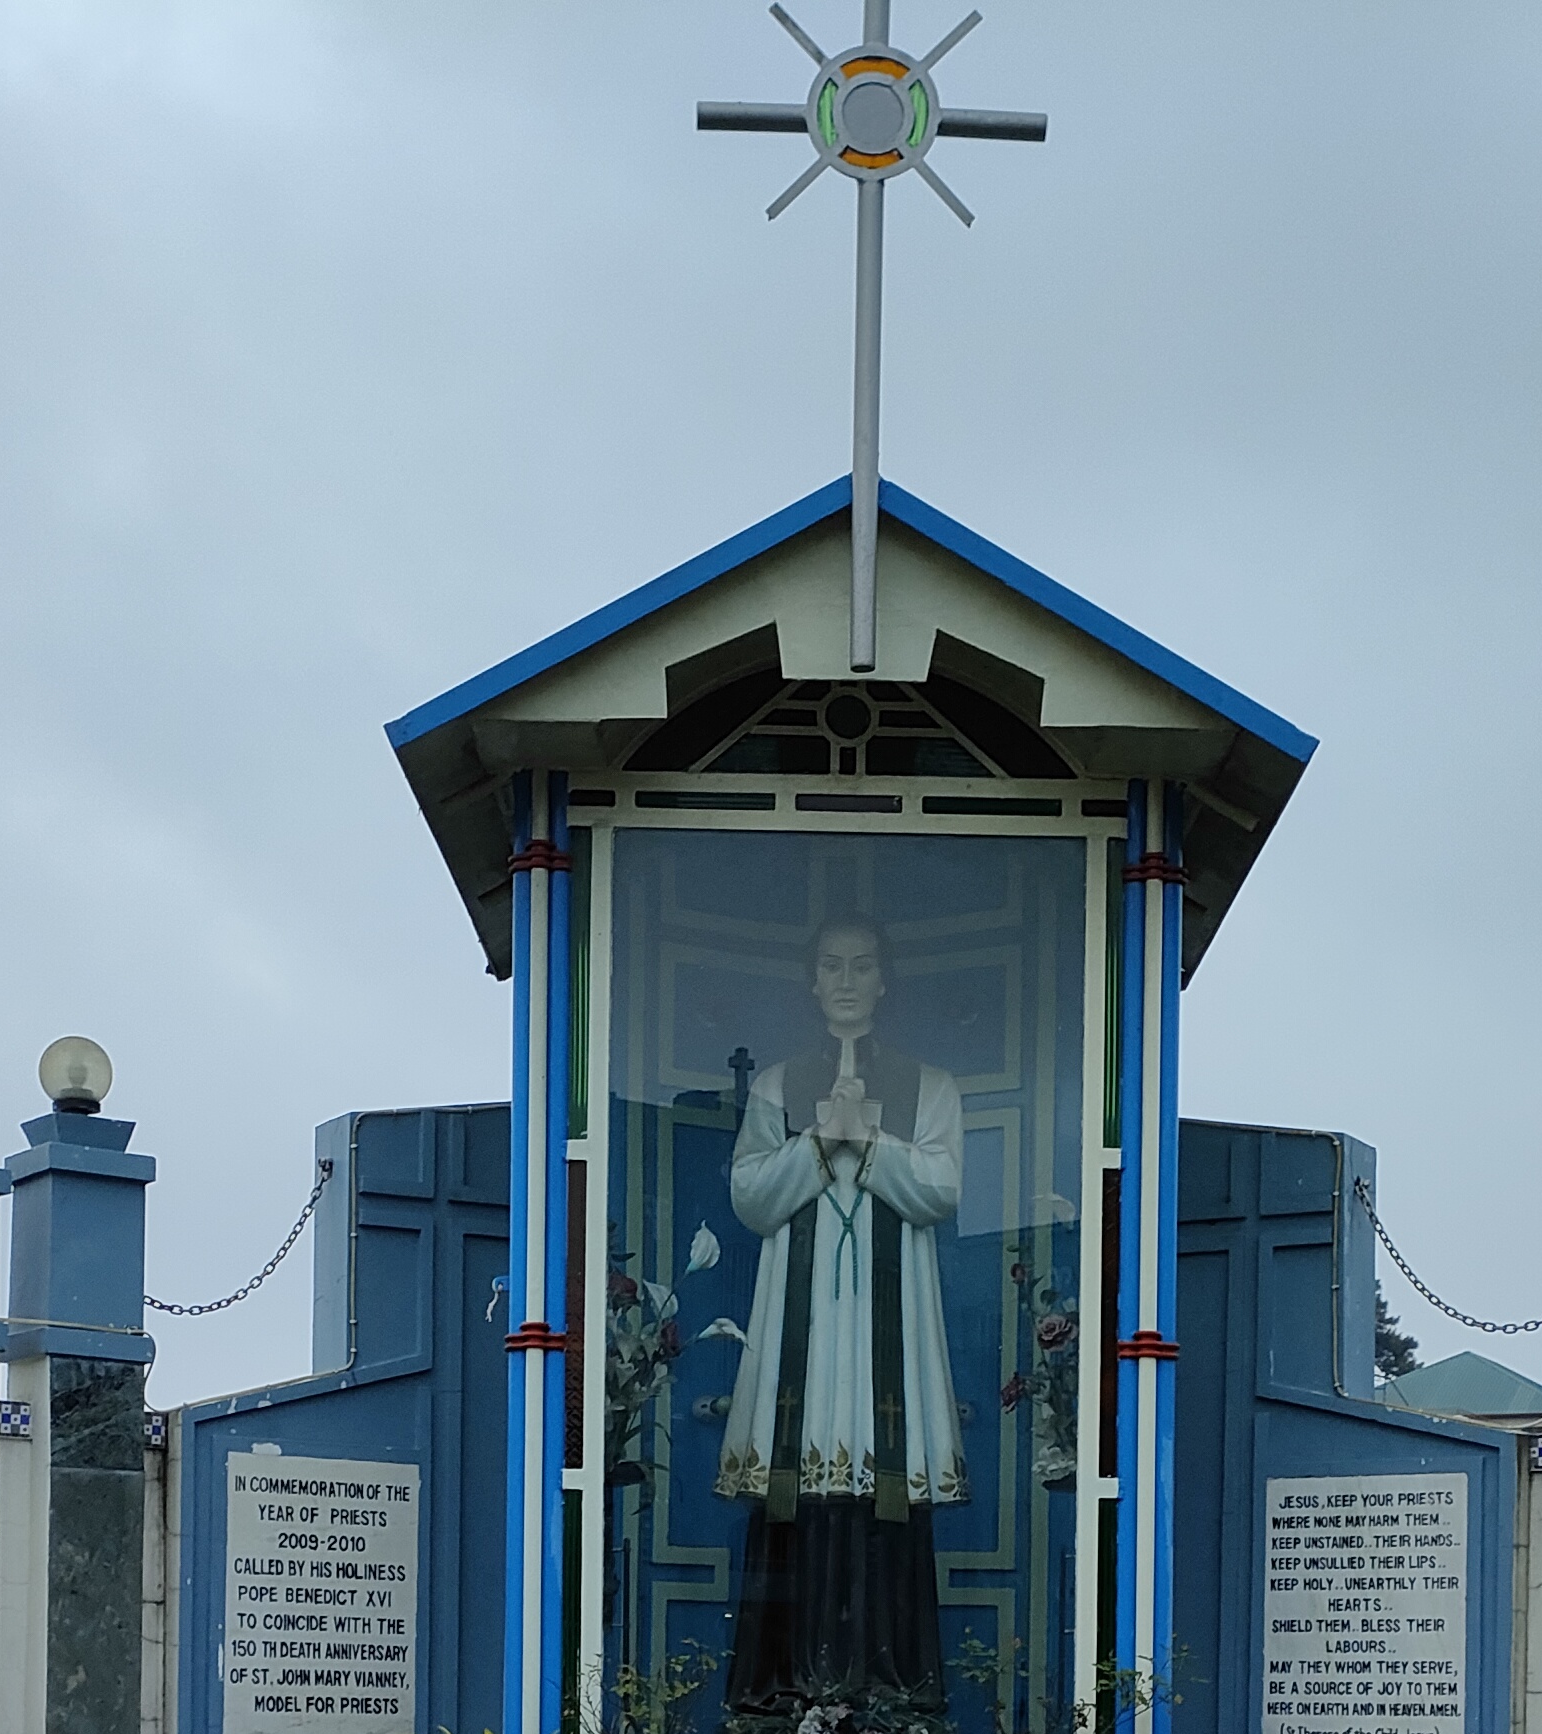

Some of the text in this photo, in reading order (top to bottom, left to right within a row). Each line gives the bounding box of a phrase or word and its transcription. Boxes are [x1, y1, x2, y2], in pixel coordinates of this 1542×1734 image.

[235, 1475, 410, 1502] IN COMMEMORATION OF THE
[1327, 1494, 1357, 1508] KEEP
[1361, 1494, 1393, 1507] YOUR
[1398, 1492, 1454, 1505] PRIESTS
[258, 1504, 387, 1527] YEAR OF PRIESTS
[1272, 1516, 1310, 1529] WHERE
[1314, 1515, 1342, 1528] NONE
[1345, 1515, 1366, 1527] MAY
[1369, 1515, 1399, 1527] HARM
[278, 1533, 366, 1551] 2009-2010
[1271, 1537, 1301, 1550] KEEP
[1374, 1535, 1411, 1548] THEIR
[234, 1558, 406, 1581] CALLED BY HIS HOLINESS
[1271, 1557, 1301, 1570] KEEP
[1304, 1557, 1365, 1570] UNSULLIED
[1370, 1556, 1405, 1569] THEIR
[1270, 1578, 1299, 1591] KEEP
[1345, 1577, 1416, 1590] UNEARTHLY
[1423, 1577, 1459, 1589] THEIR
[238, 1586, 392, 1608] POPE BENEDICT XVI
[237, 1613, 405, 1634] TO COINCIDE WITH THE
[1272, 1619, 1312, 1633] SHIELD
[1361, 1619, 1401, 1632] BLESS
[1406, 1619, 1445, 1632] THEIR
[232, 1640, 408, 1662] 150 TH DEATH ANNIVERSARY
[1270, 1661, 1458, 1677] MAY THEY WHOM THEY SERVE,
[230, 1669, 409, 1690] OF ST. JOHN MARY VIANNEY,
[1269, 1681, 1458, 1696] BE A SOURCE OF JOY TO THEM
[254, 1696, 399, 1715] MODEL FOR PRIESTS
[1267, 1702, 1294, 1715] HERE
[1297, 1703, 1310, 1715] ON
[1313, 1702, 1349, 1716] EARTH
[1352, 1703, 1374, 1716] AND
[1376, 1703, 1386, 1716] IN
